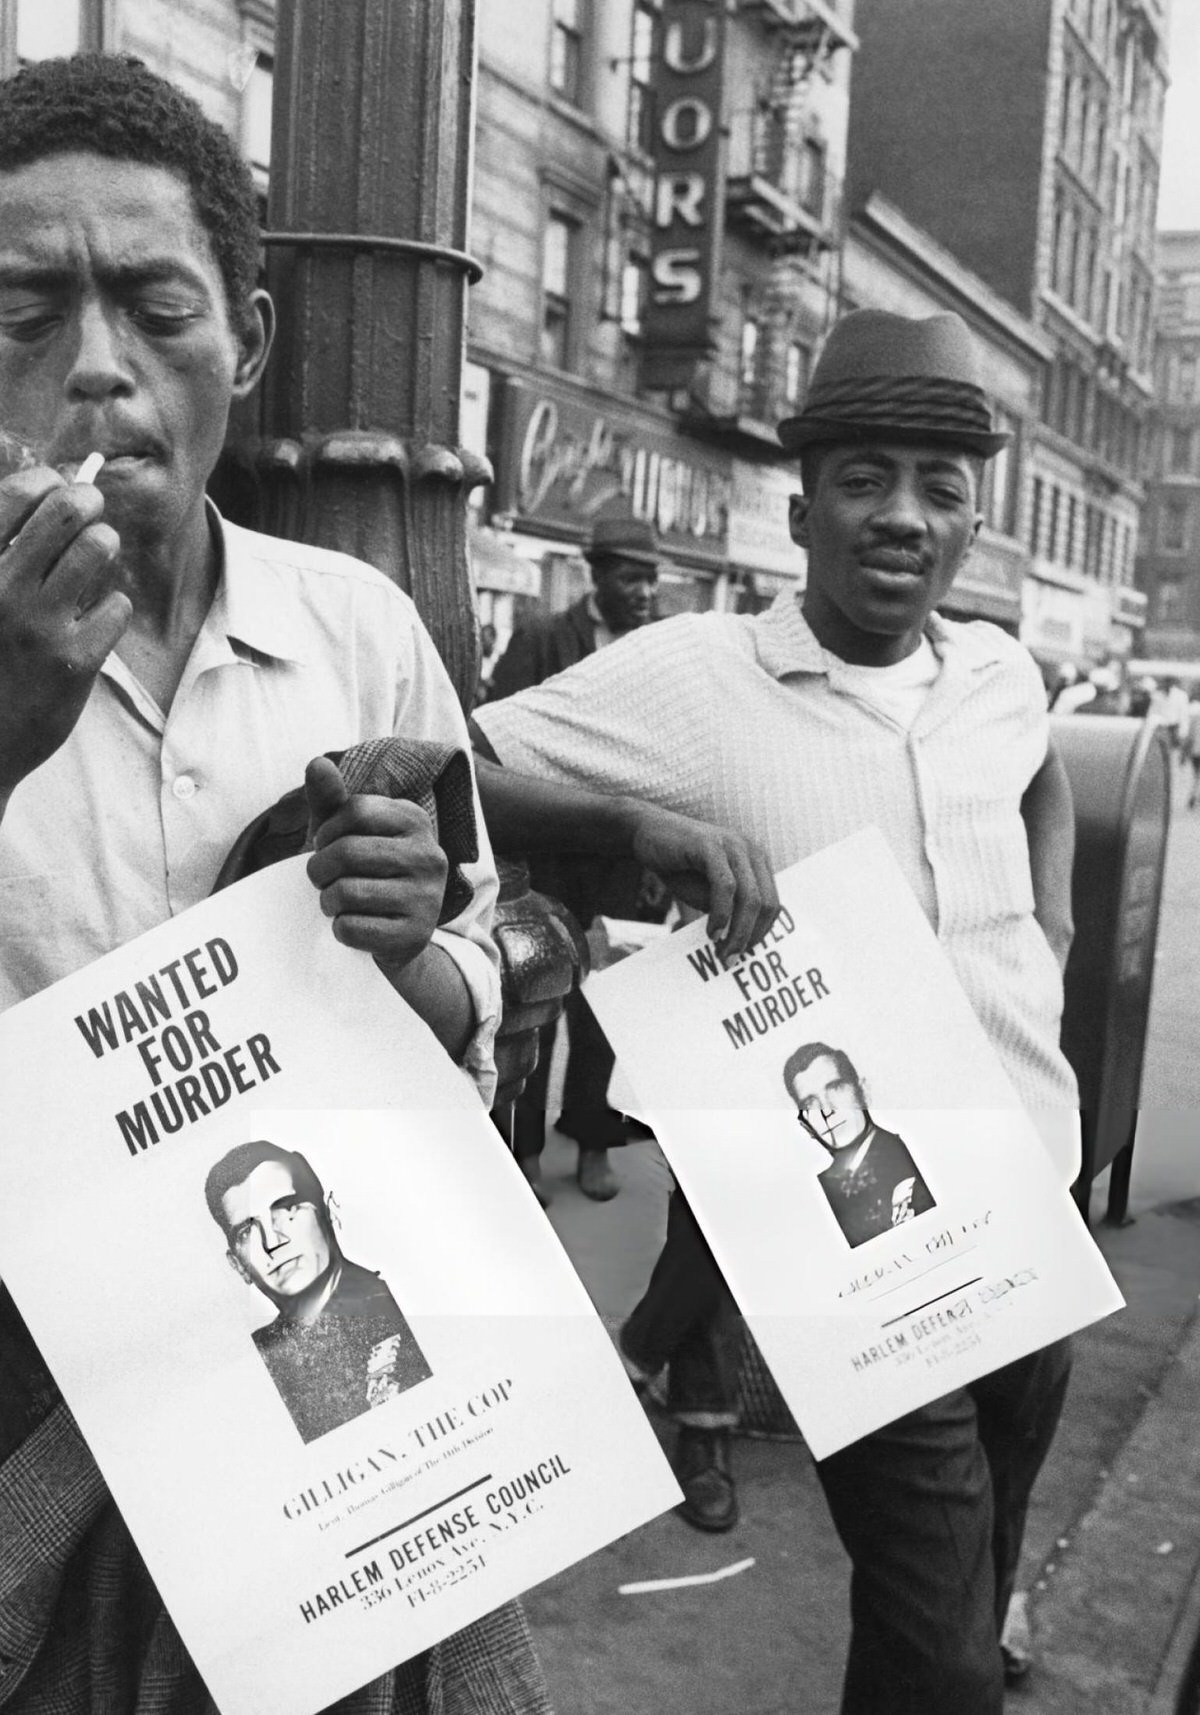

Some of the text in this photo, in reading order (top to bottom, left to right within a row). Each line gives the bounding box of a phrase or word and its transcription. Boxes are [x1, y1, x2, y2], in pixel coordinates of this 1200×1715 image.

[74, 937, 239, 1059] WANTED
[721, 967, 831, 1050] MURDER
[731, 950, 789, 1002] FOR
[136, 1009, 222, 1087] FOR
[114, 1032, 282, 1157] MURDER
[851, 1332, 908, 1372] HARLEM
[409, 1407, 465, 1449] THE
[467, 1376, 514, 1417] COP
[300, 1455, 570, 1623] HARLEM DEFENSE COUNCIL
[359, 1585, 393, 1611] 336
[392, 1558, 446, 1592] Lenox
